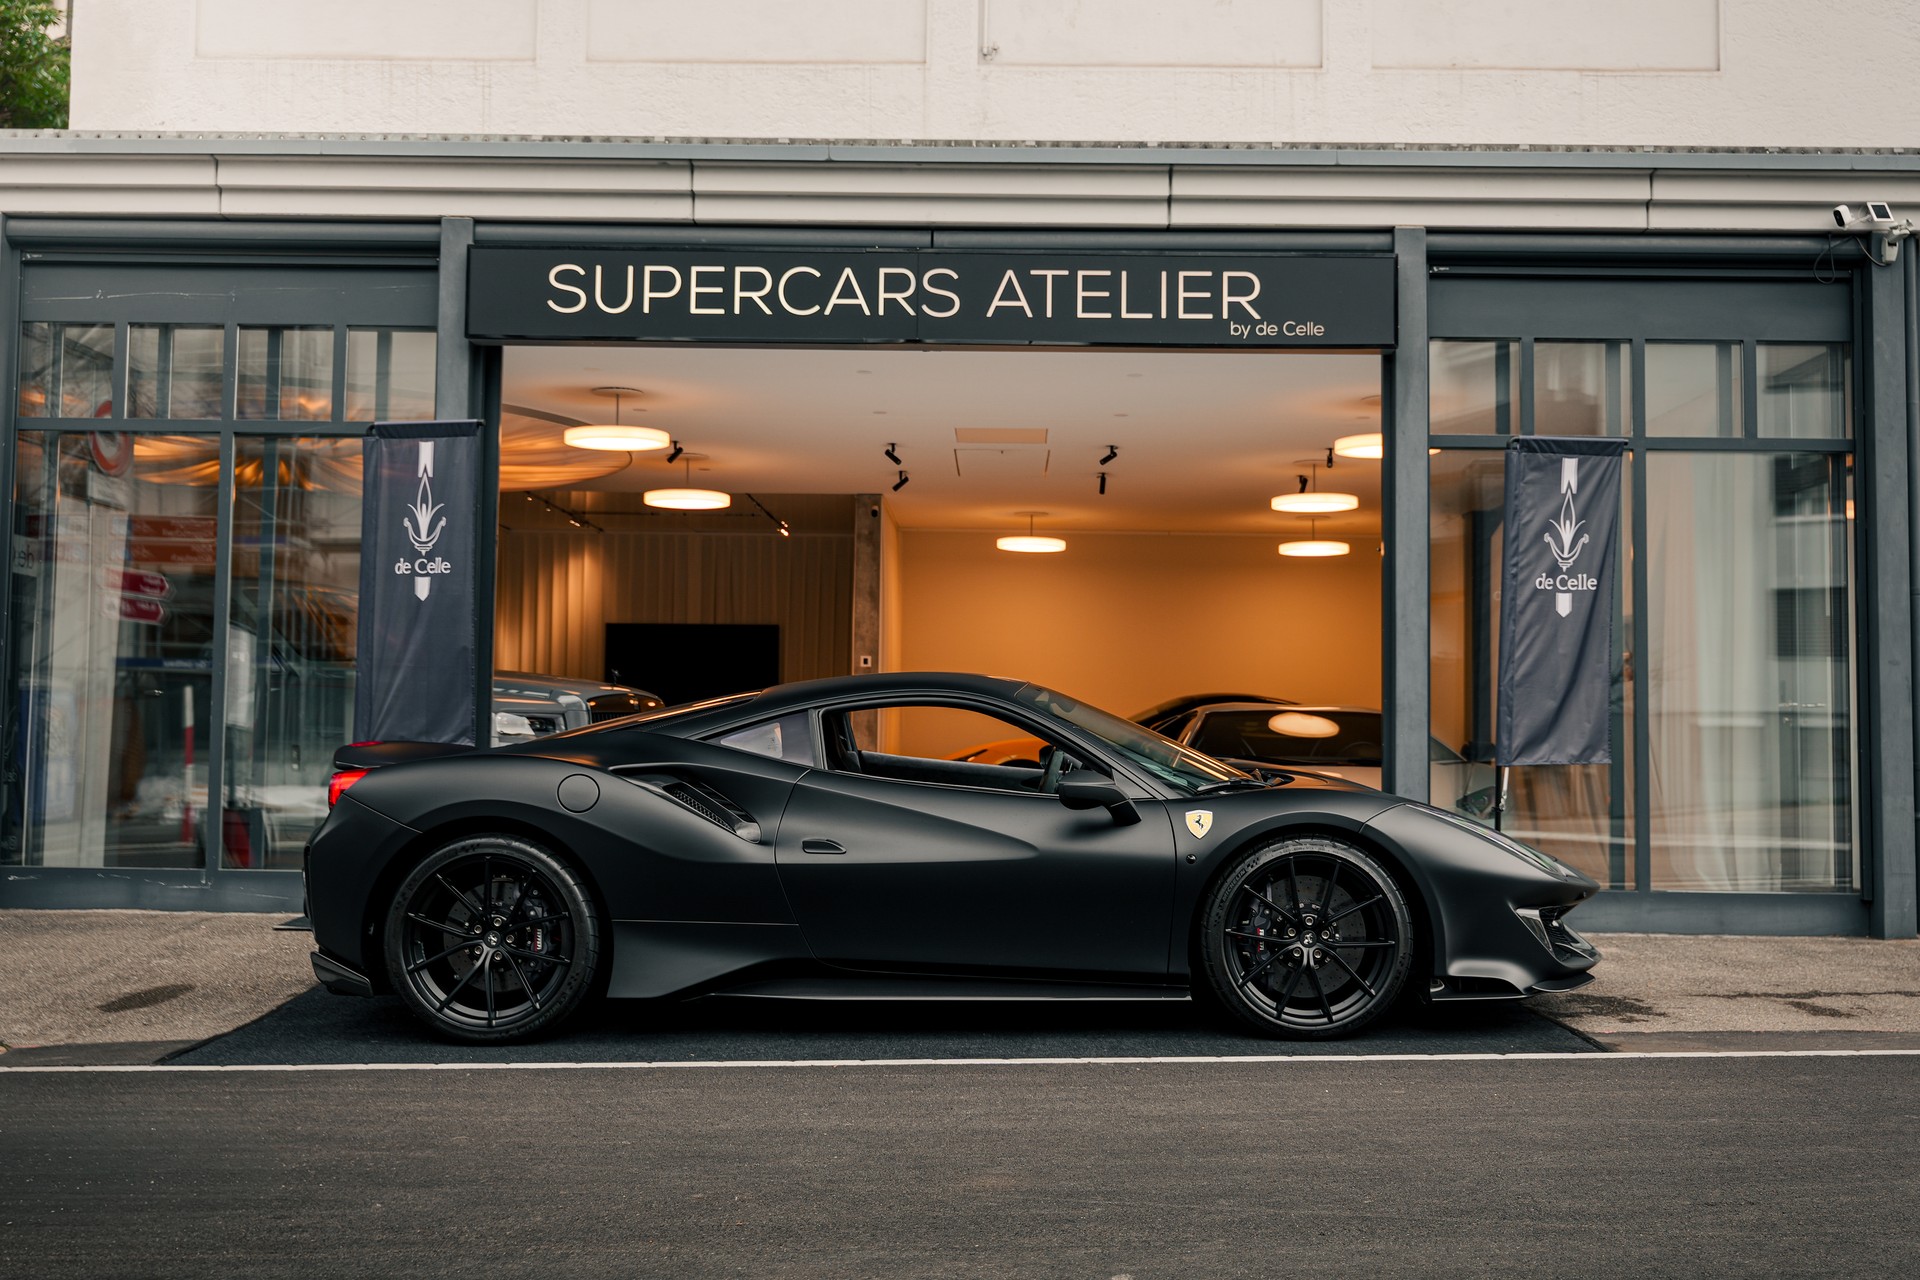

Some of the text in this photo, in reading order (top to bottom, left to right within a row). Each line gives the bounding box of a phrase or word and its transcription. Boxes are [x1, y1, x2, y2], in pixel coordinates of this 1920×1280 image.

[546, 263, 1262, 320] SUPERCARS ATELIER
[1230, 320, 1326, 340] by de Celle
[394, 556, 452, 575] de Celle
[1535, 572, 1598, 591] de Celle
[1221, 868, 1247, 903] MICHELIN
